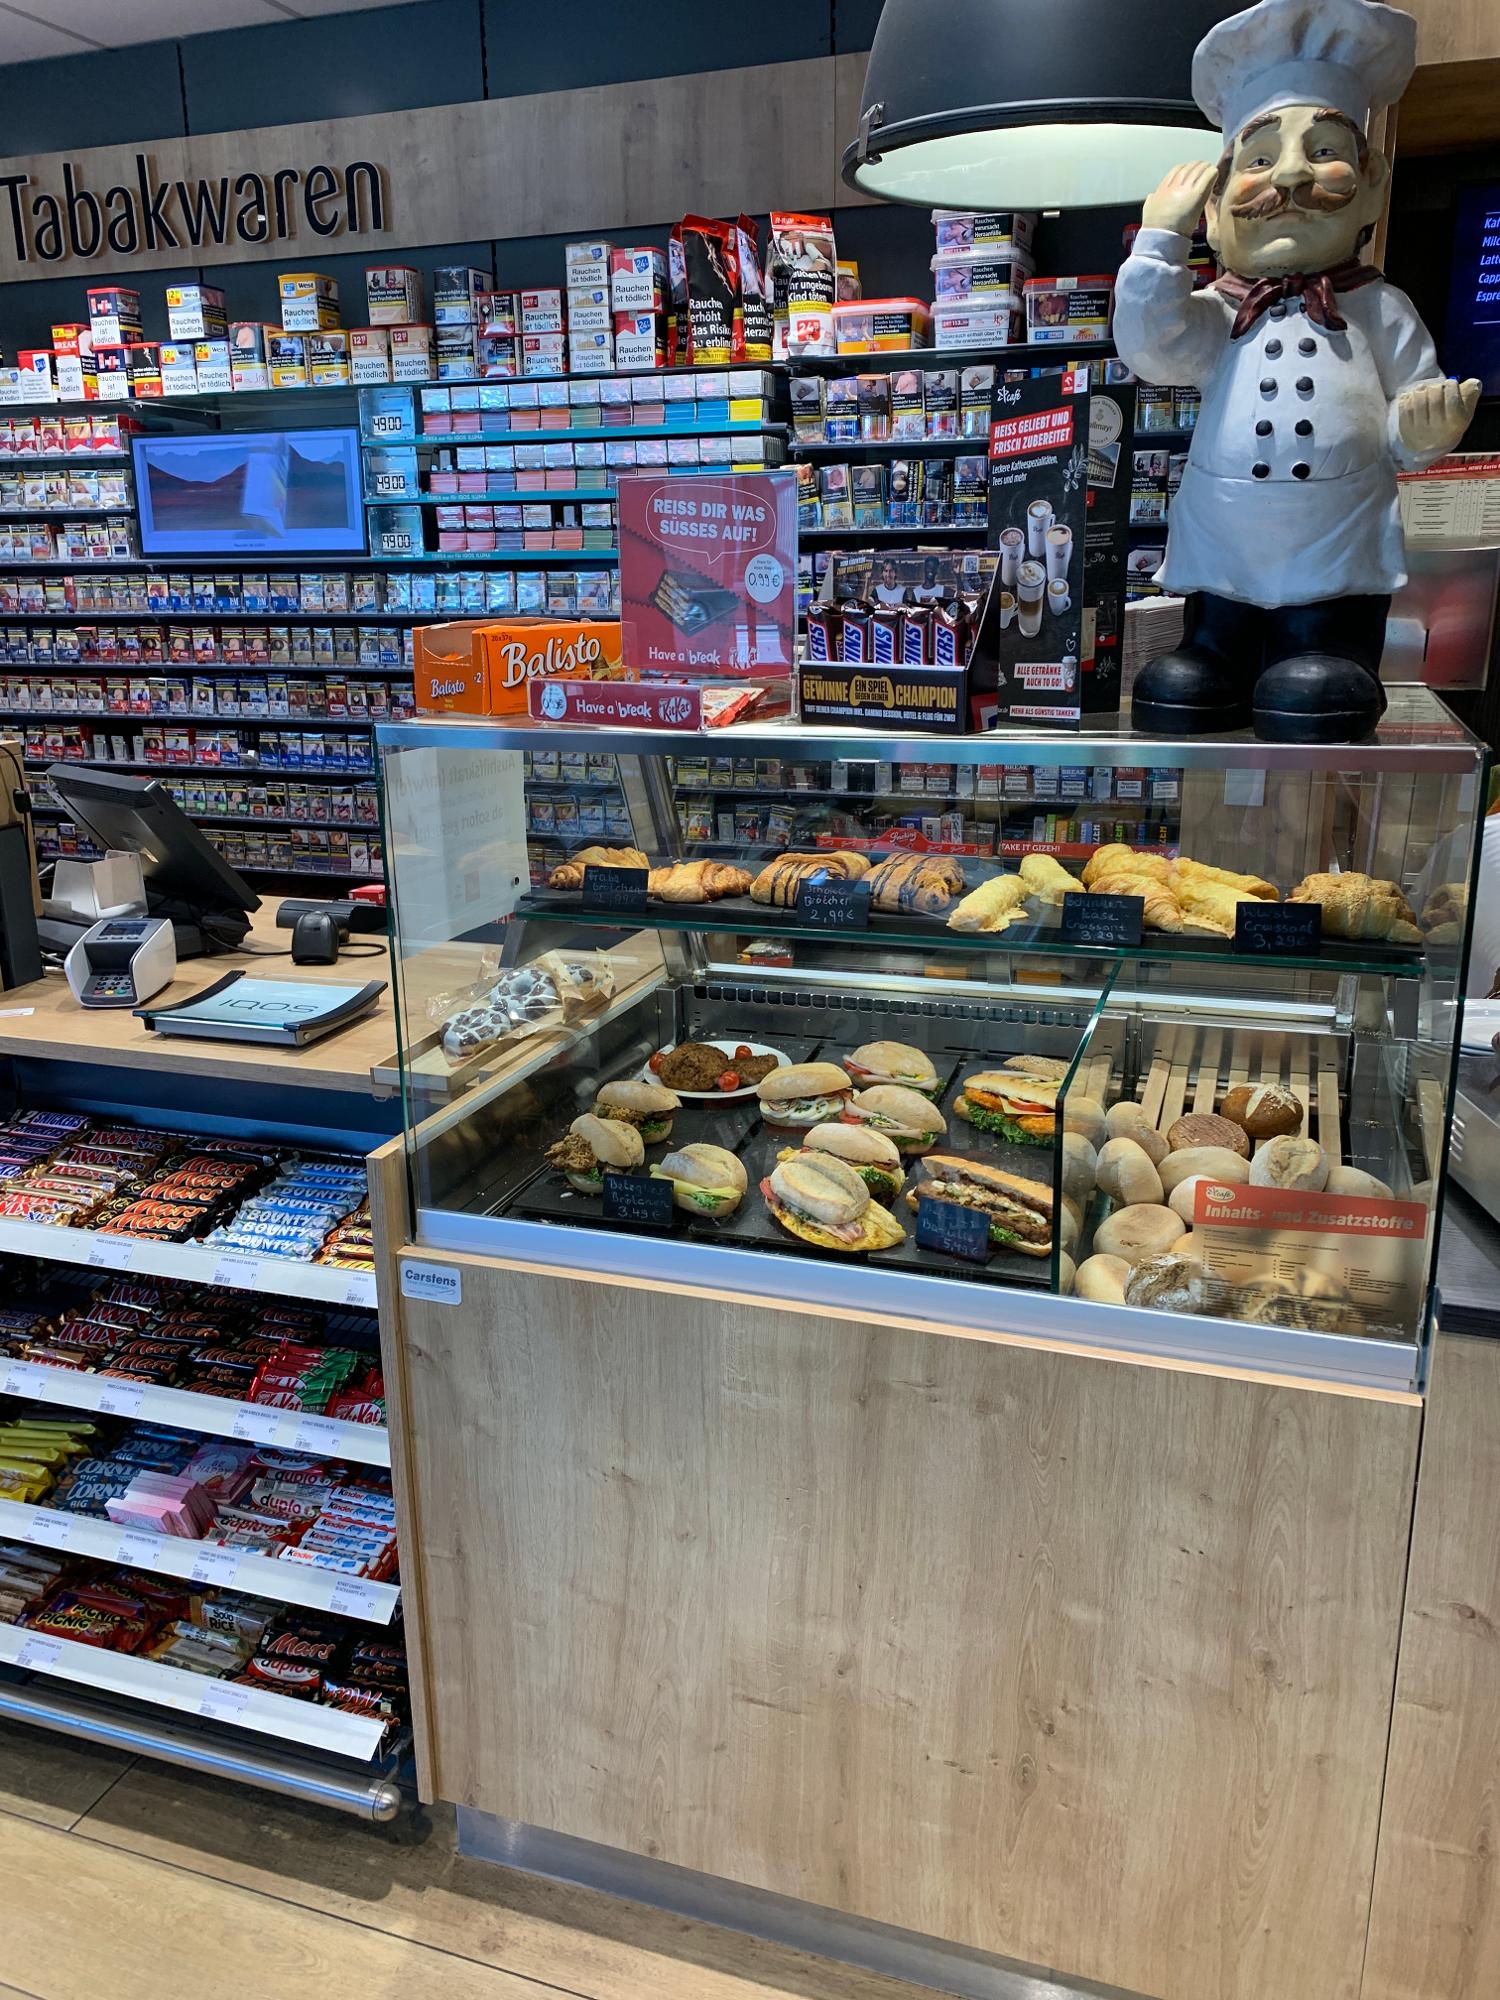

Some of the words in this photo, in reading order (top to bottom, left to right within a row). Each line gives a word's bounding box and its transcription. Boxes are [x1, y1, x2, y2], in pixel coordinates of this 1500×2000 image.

[0, 154, 385, 262] Tabakwaren
[571, 267, 601, 275] Rauchen
[580, 274, 602, 282] tödlich
[615, 285, 650, 293] Rauchen
[625, 293, 652, 302] tödlich
[283, 309, 315, 317] Rauchen
[525, 313, 558, 322] Rauchen
[573, 311, 603, 319] Rauchen
[690, 310, 722, 323] erhöht
[692, 323, 709, 336] das
[619, 346, 652, 354] Rauchen
[628, 354, 654, 364] tödlich
[354, 361, 386, 370] Rauchen
[394, 359, 427, 368] Rauchen
[403, 367, 430, 377] tödlich
[362, 369, 388, 379] tödlich
[994, 421, 1017, 440] HEISS
[1018, 414, 1051, 436] GELIEBT
[1051, 410, 1070, 427] UND
[993, 436, 1021, 456] FRISCH
[1022, 427, 1071, 452] ZUBEREITET
[992, 462, 1011, 475] Leckere
[1010, 454, 1059, 472] Kaffeespezialitäten,
[992, 476, 1003, 487] Tees
[1003, 475, 1013, 485] und
[1013, 471, 1028, 484] mehr
[653, 498, 697, 518] REISS
[701, 502, 727, 520] DIR
[731, 504, 766, 522] WAS
[659, 516, 718, 540] SÜSSES
[721, 525, 757, 543] AUF!
[500, 632, 601, 689] Balisto
[648, 646, 676, 662] Have
[677, 653, 685, 663] a
[687, 648, 721, 669] break
[1016, 665, 1030, 676] ALLE
[1031, 664, 1062, 676] GETRÄNKE
[430, 678, 466, 698] Balisto
[1026, 677, 1042, 688] AUCH
[1042, 677, 1051, 687] TO
[1050, 677, 1062, 687] GO!
[802, 679, 849, 702] GEWINNE
[854, 678, 867, 691] EIN
[867, 679, 889, 694] SPIEL
[895, 683, 957, 709] CHAMPION
[854, 691, 871, 701] GEGEN
[870, 692, 889, 702] DEINEN
[576, 699, 598, 714] Have
[607, 704, 615, 715] a
[617, 703, 652, 719] break
[922, 712, 934, 721] FLUG
[933, 711, 943, 721] FÜR
[1024, 707, 1034, 716] ALS
[1034, 706, 1056, 717] GÜNSTIG
[1000, 843, 1021, 852] TAKE
[1021, 843, 1030, 851] IT
[1032, 844, 1061, 853] GIZEH!
[218, 999, 320, 1014] IQOS
[32, 1112, 84, 1129] SNICKERS
[88, 1129, 137, 1146] TWIX
[69, 1149, 122, 1165] TWIX
[179, 1155, 258, 1177] Mars
[163, 1168, 245, 1189] Mars
[140, 1182, 222, 1201] Mars
[281, 1185, 348, 1201] BOUNTY
[123, 1199, 208, 1218] Mars
[266, 1196, 334, 1213] BOUNTY
[105, 1211, 192, 1231] Mars
[247, 1209, 315, 1227] BOUNTY
[1272, 1210, 1306, 1224] und
[1307, 1209, 1415, 1231] Zusatzstoffe
[242, 1221, 310, 1238] BOUNTY
[225, 1232, 294, 1251] BOUNTY
[405, 1269, 457, 1288] Carstens
[109, 1282, 164, 1306] TWIX
[86, 1303, 150, 1328] TWIX
[58, 1321, 127, 1348] TWIX
[121, 1339, 190, 1355] Mars
[110, 1353, 179, 1374] Mars
[72, 1457, 135, 1477] CORNY
[274, 1470, 319, 1486] duplo
[66, 1480, 127, 1501] CORNY
[338, 1487, 364, 1500] kinder
[69, 1499, 89, 1508] BIG
[260, 1493, 302, 1515] duplo
[328, 1502, 353, 1514] kinder
[352, 1506, 381, 1520] Riegel
[320, 1518, 346, 1531] kinder
[346, 1521, 375, 1536] Riegel
[309, 1531, 335, 1544] kinder
[334, 1536, 363, 1551] Riegel
[286, 1547, 313, 1561] kinder
[313, 1553, 341, 1569] Riegel
[36, 1611, 93, 1630] PICNIC
[70, 1603, 121, 1624] PICNIC
[265, 1631, 337, 1660] Mars
